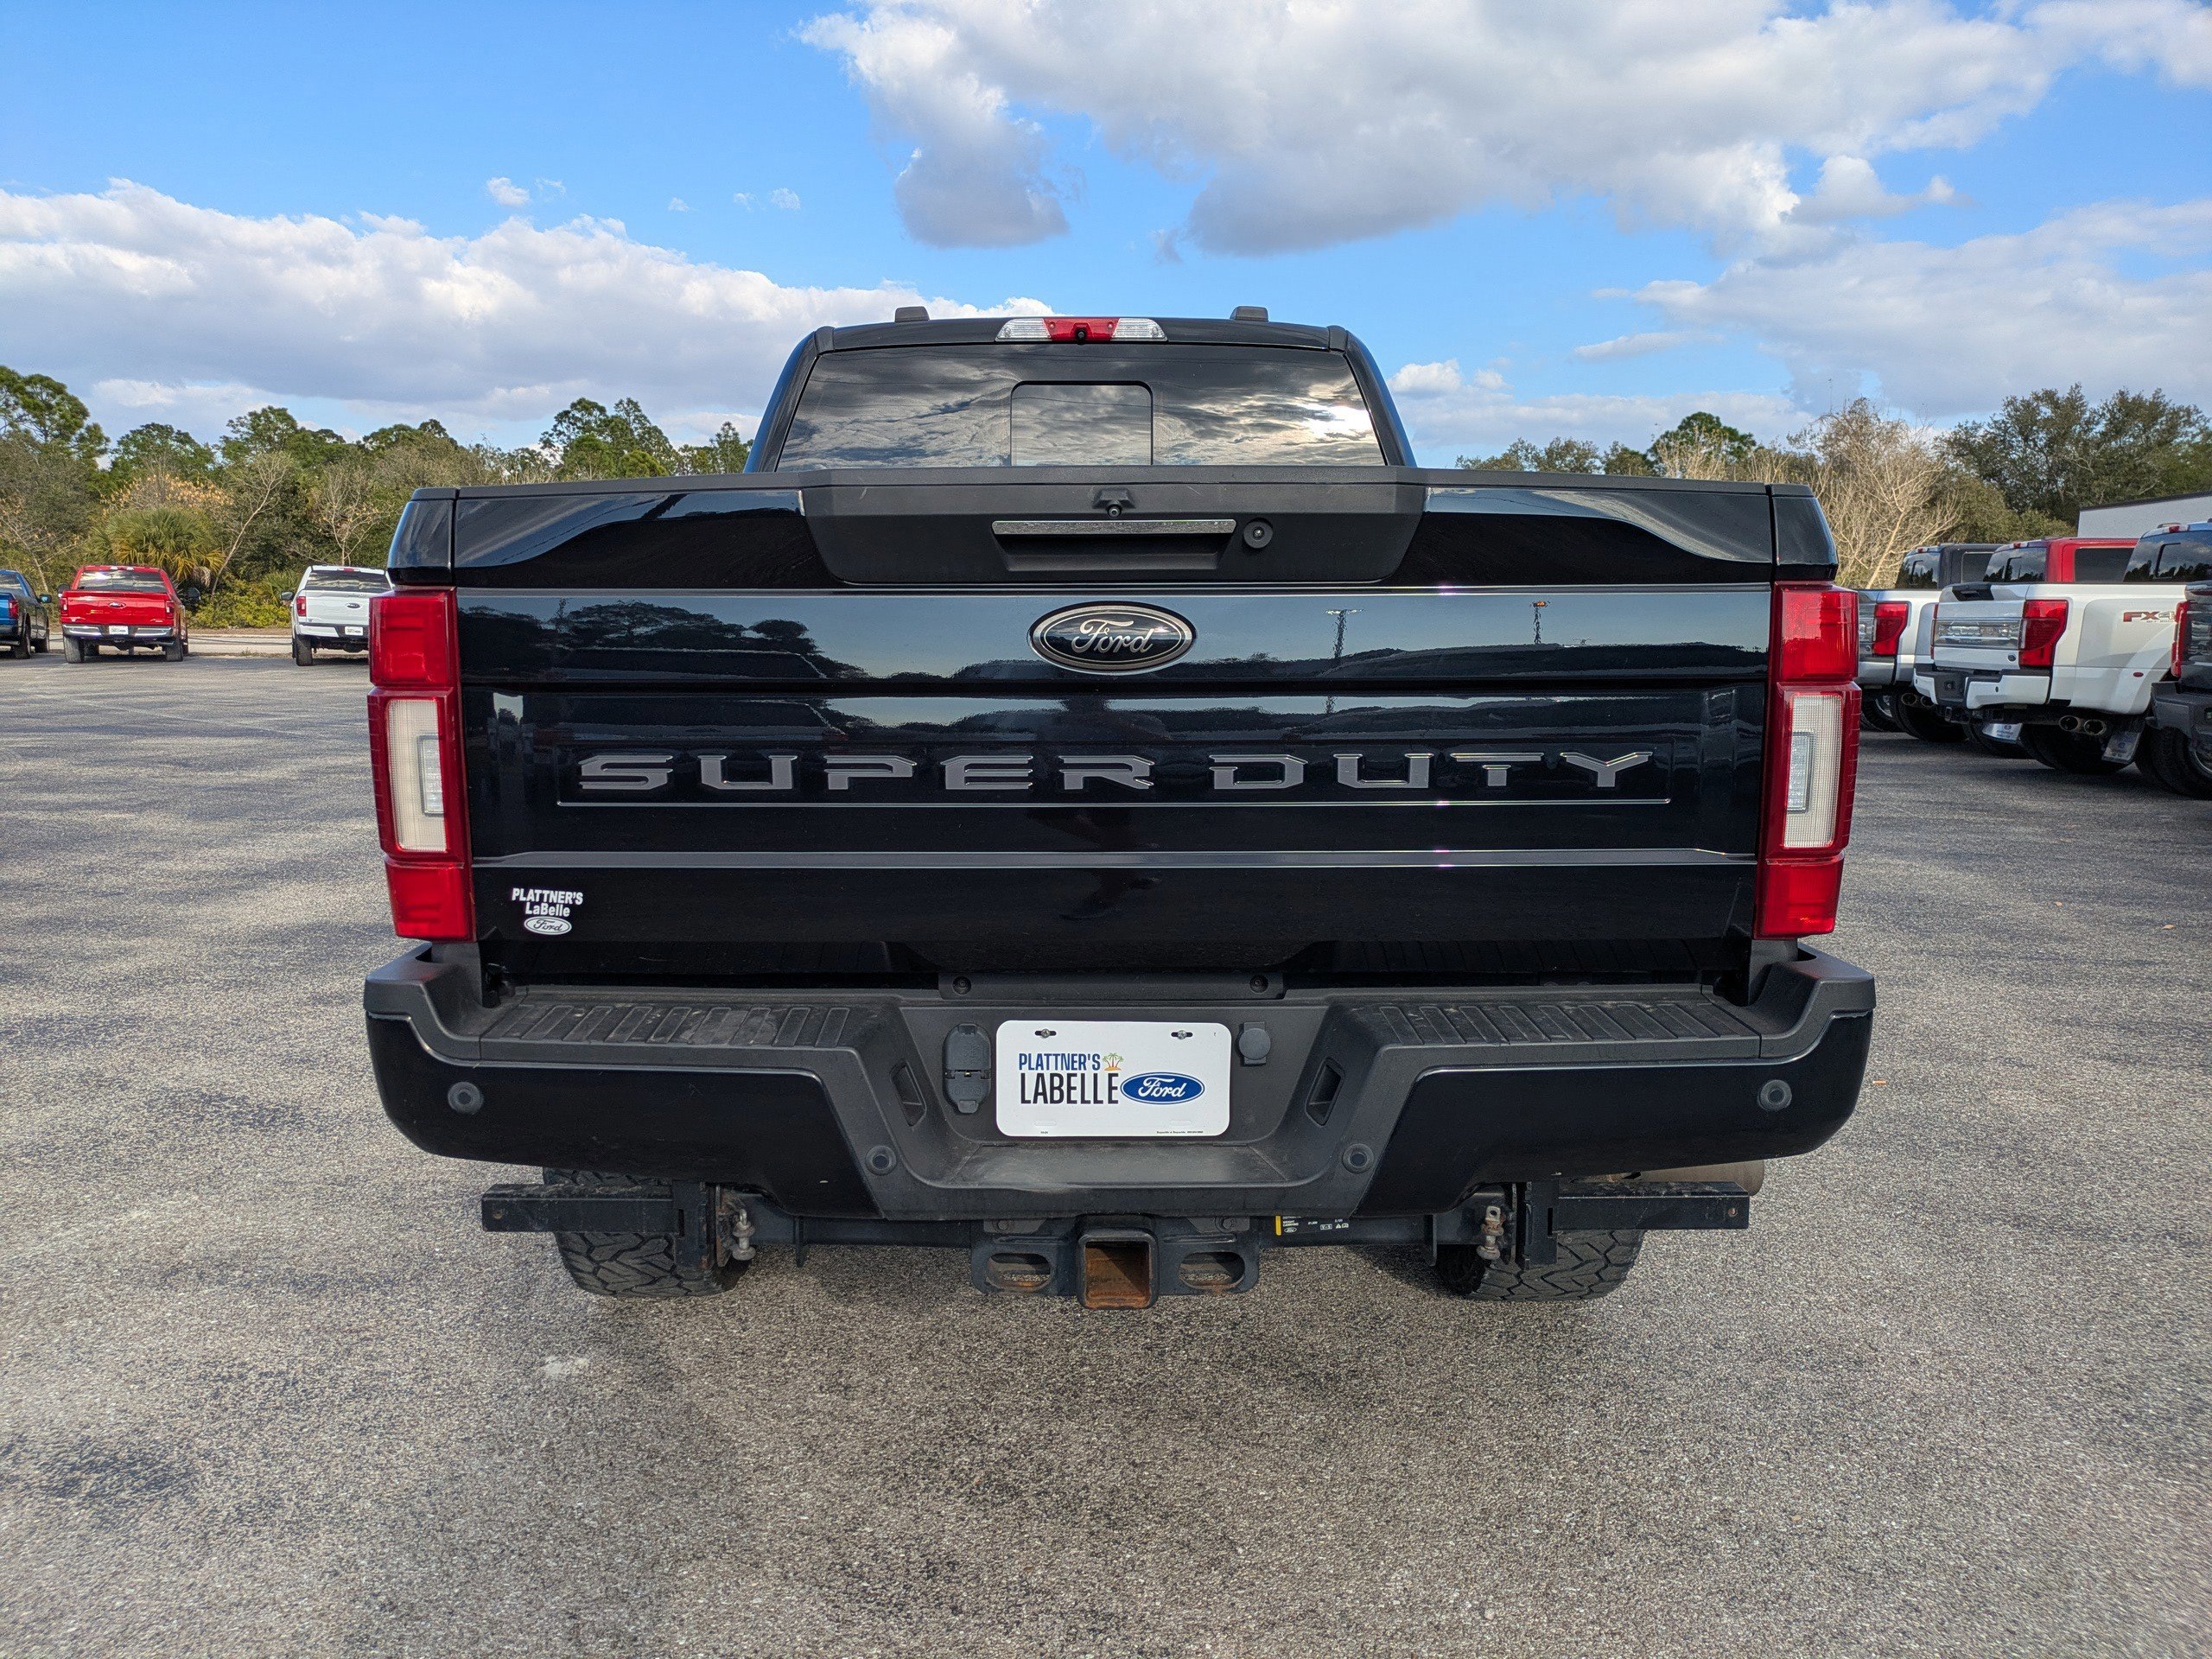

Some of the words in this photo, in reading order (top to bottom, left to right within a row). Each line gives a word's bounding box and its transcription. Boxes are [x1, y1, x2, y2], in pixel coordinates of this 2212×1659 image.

[1071, 619, 1154, 652] Ford
[578, 754, 1154, 790] SUPER
[1211, 753, 1652, 789] DUTY
[512, 887, 583, 905] PLATTNER'S
[525, 901, 570, 917] LaBelle
[533, 919, 563, 931] Ford
[1019, 1052, 1101, 1071] PLATTNER'S
[1020, 1072, 1119, 1104] LABELLE
[1137, 1077, 1186, 1098] Ford
